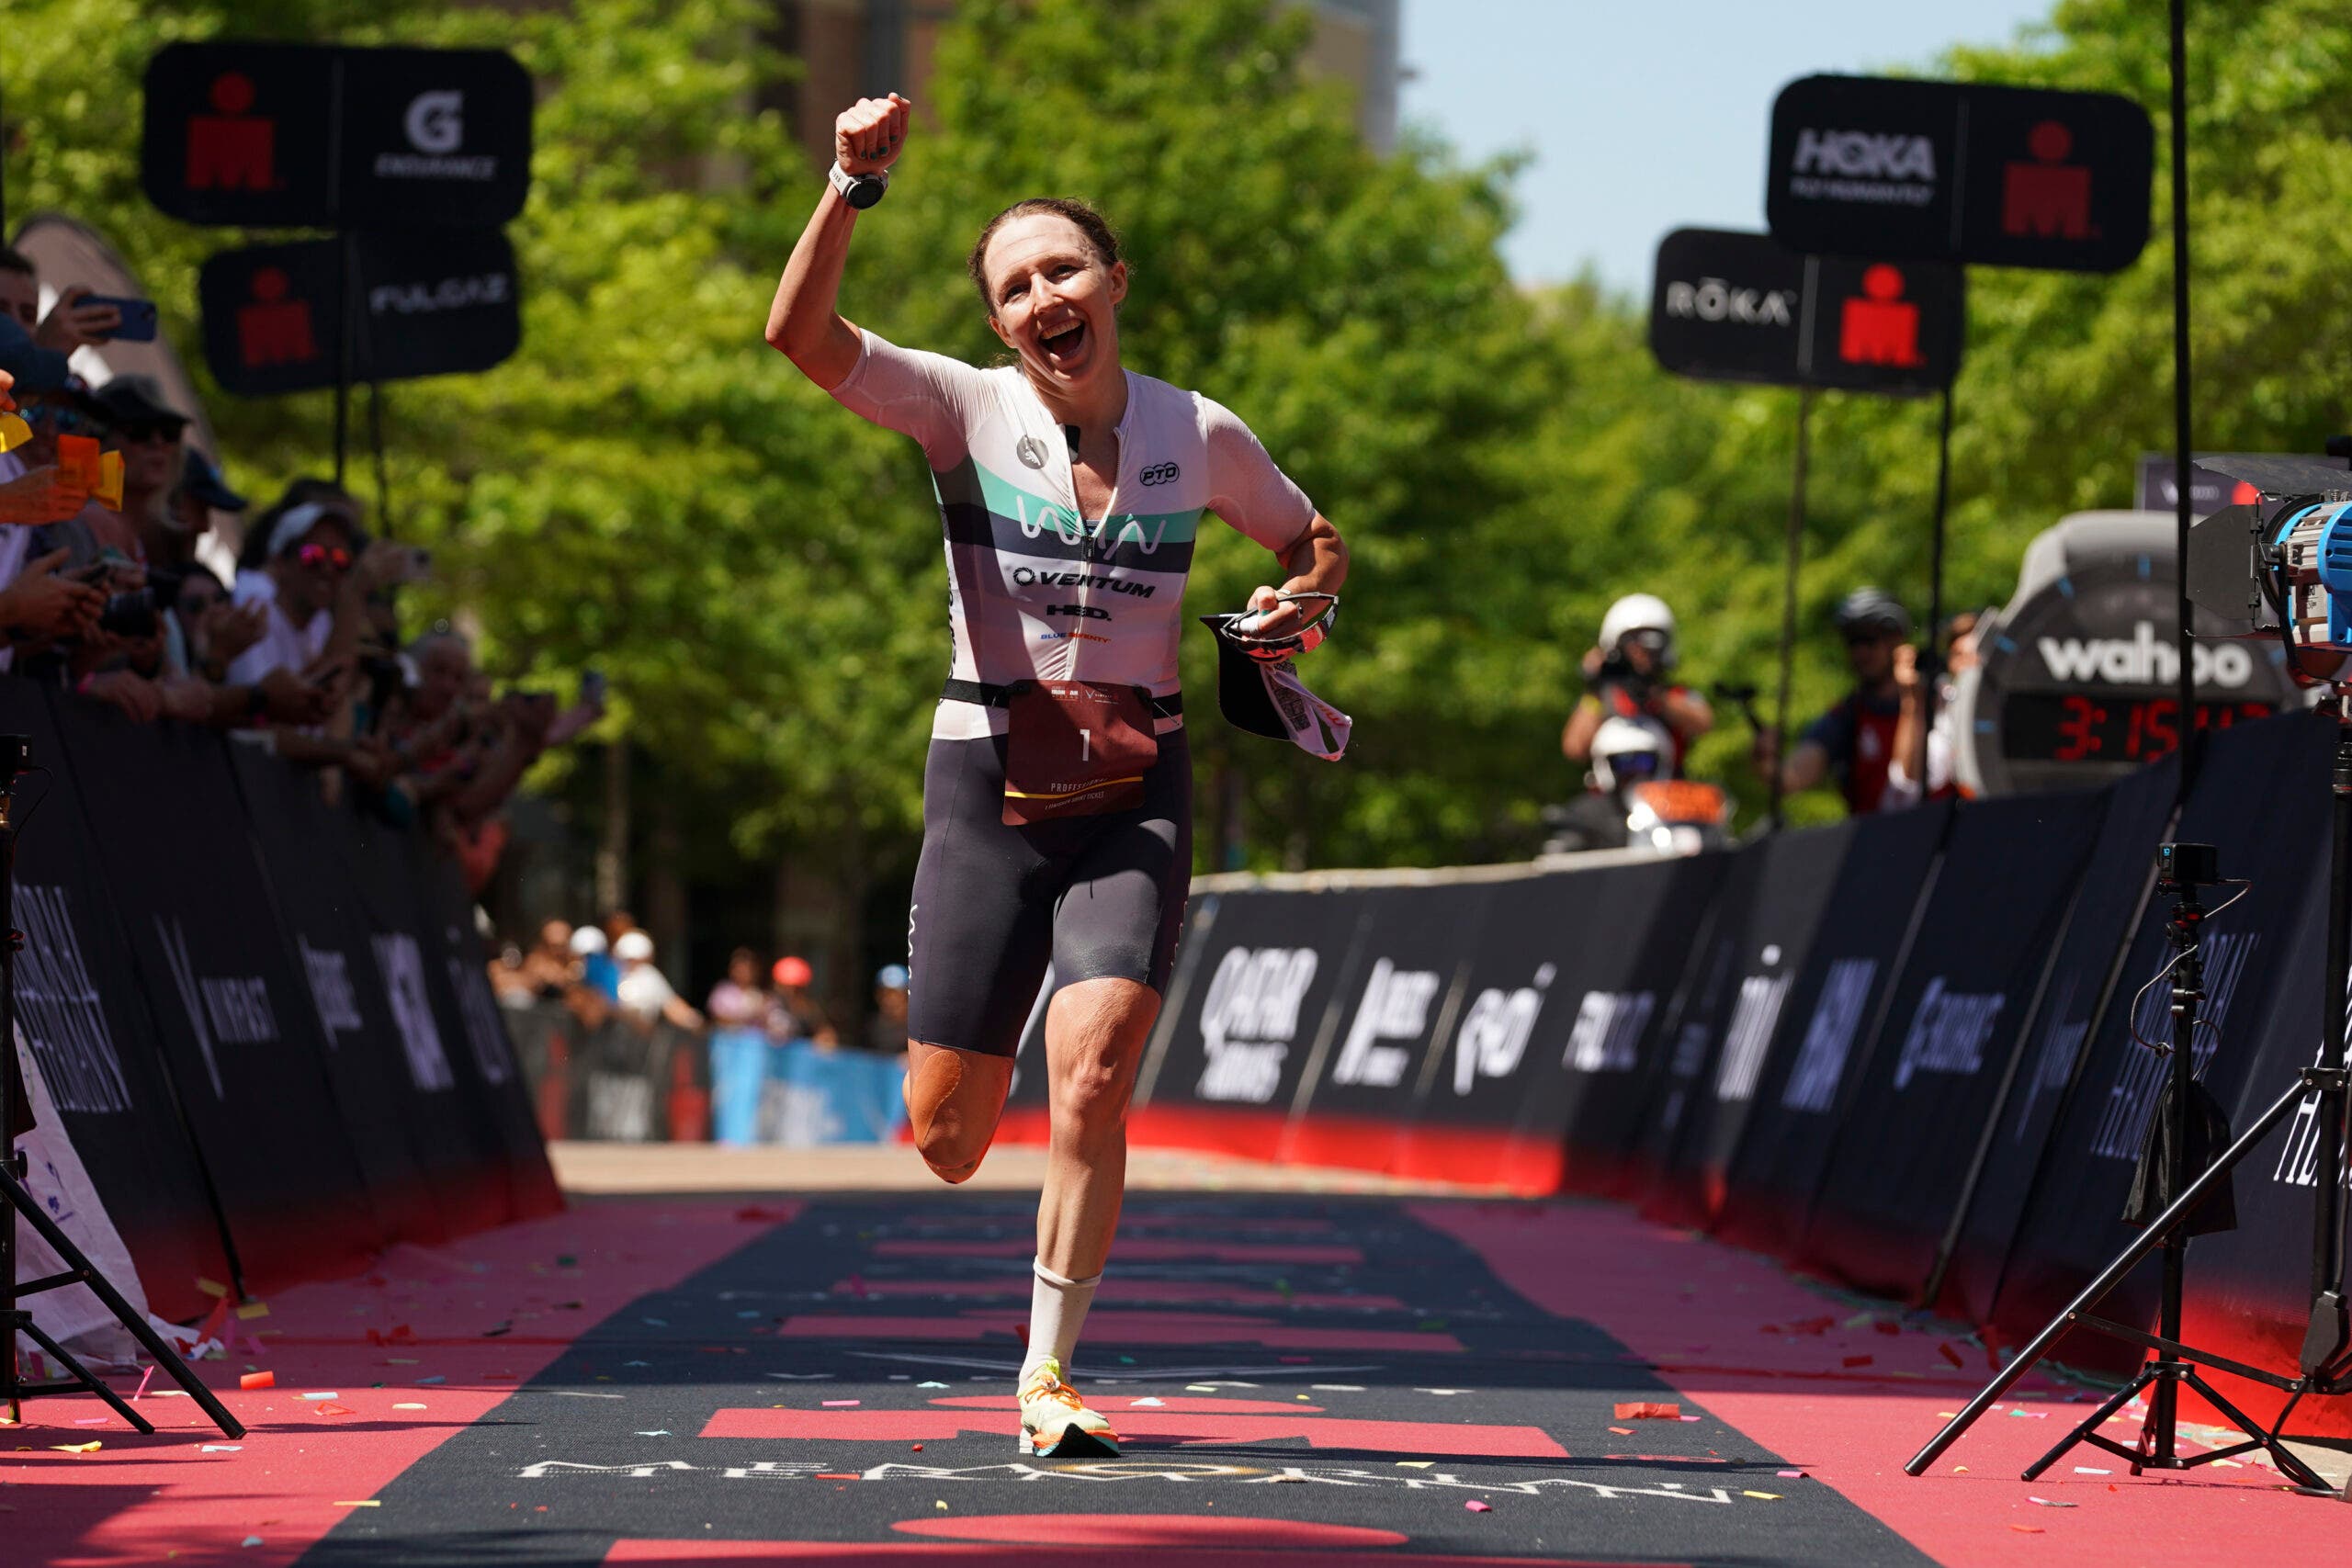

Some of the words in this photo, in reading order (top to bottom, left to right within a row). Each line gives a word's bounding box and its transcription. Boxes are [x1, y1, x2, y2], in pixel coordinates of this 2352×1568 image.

[404, 90, 464, 152] G
[1792, 127, 1937, 180] HOKA
[1142, 465, 1177, 483] PTO
[1040, 571, 1155, 598] VENTUM
[2037, 621, 2254, 687] wahoo
[1080, 728, 1091, 761] 1
